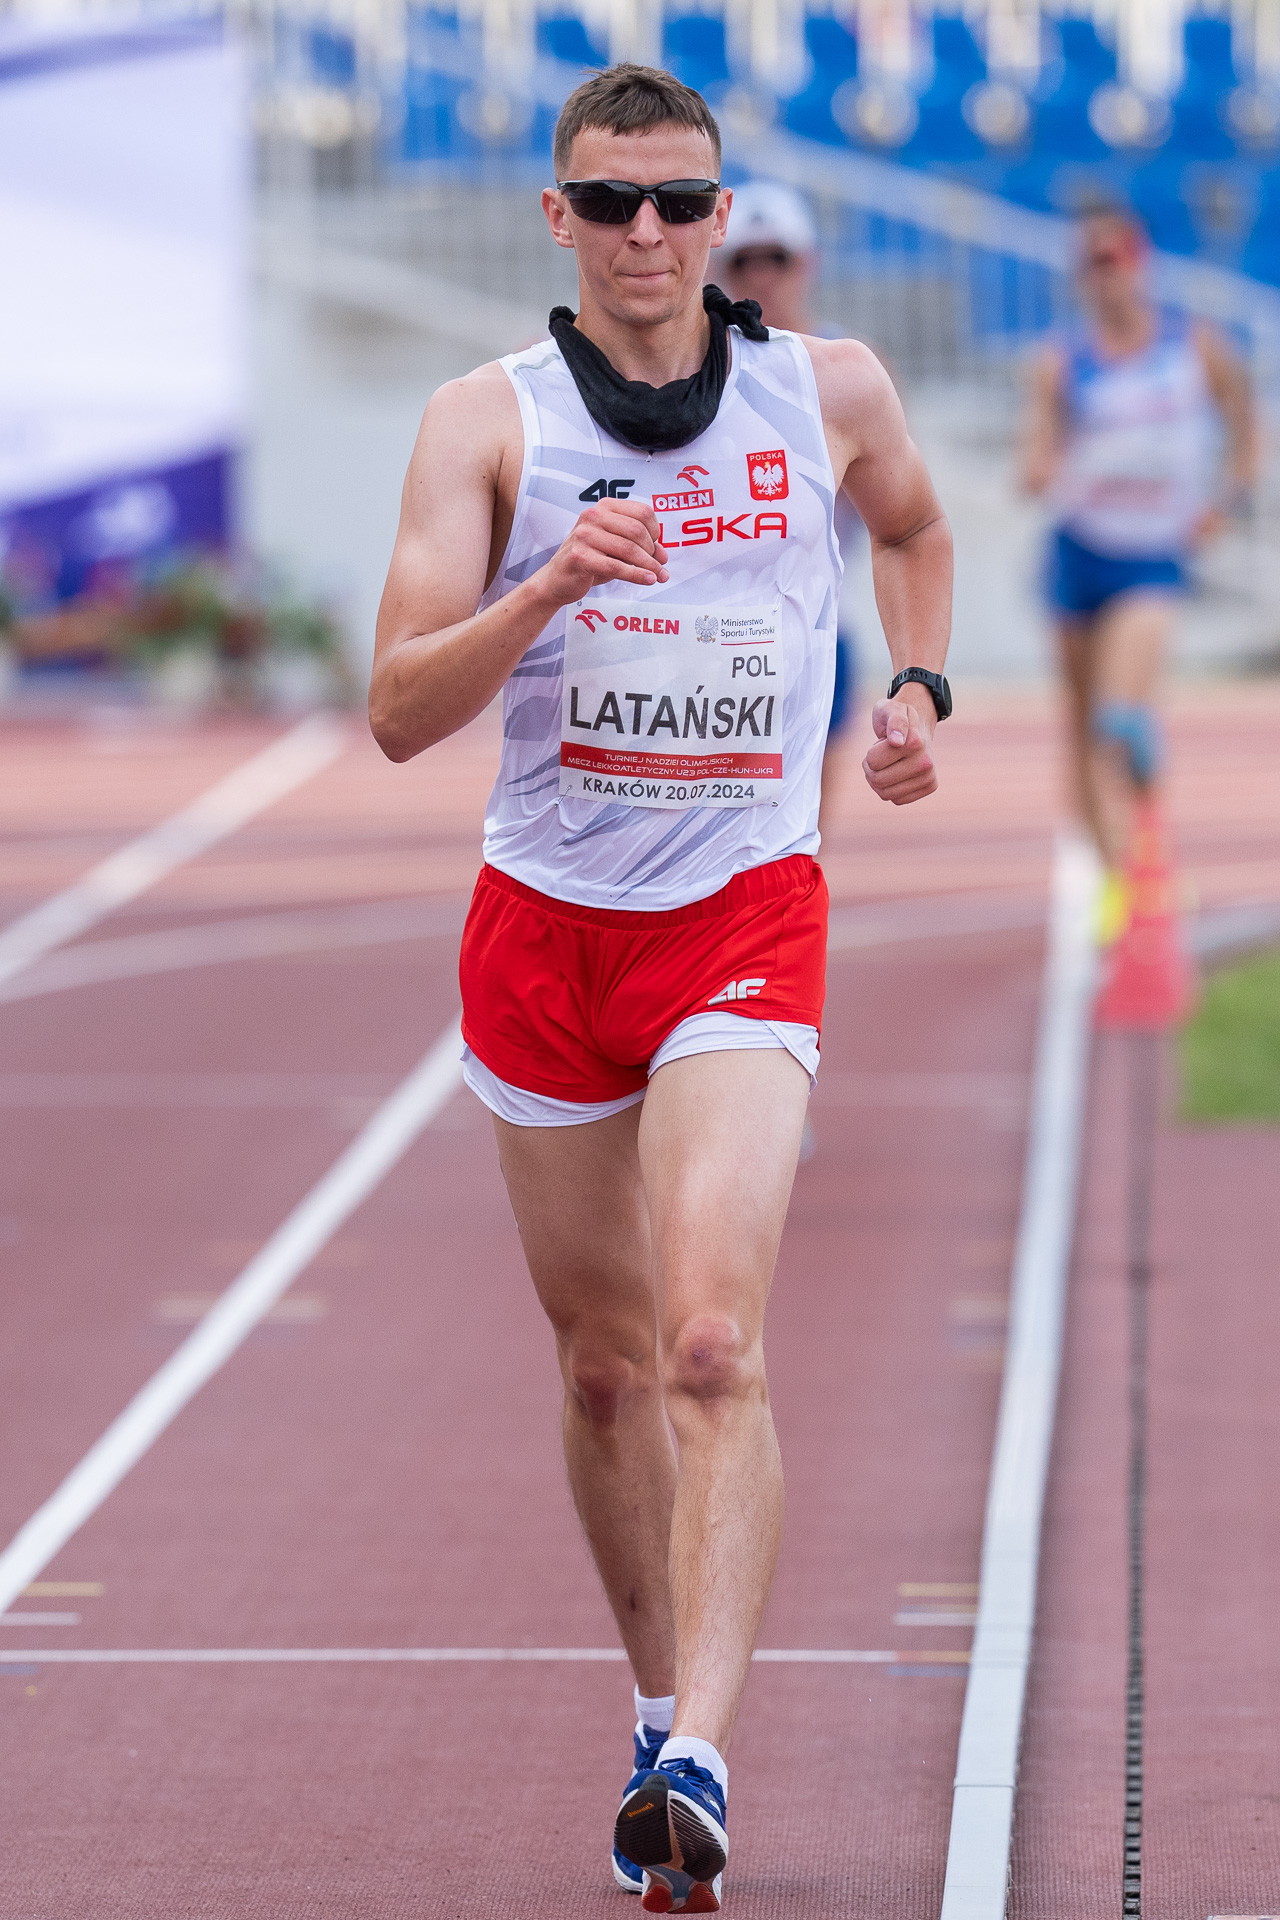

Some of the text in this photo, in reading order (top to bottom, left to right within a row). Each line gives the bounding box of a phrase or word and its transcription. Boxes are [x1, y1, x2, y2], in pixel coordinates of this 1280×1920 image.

[749, 452, 783, 462] POLSKA
[655, 492, 711, 510] ORLEN
[658, 512, 787, 548] LSKA
[613, 615, 680, 635] ORLEN
[720, 618, 764, 627] Ministerstwo
[720, 628, 745, 638] Sportu
[749, 626, 775, 636] Turystyki
[732, 655, 776, 678] POL
[569, 685, 775, 739] LATAŃSKI
[567, 756, 774, 777] MECZ LEKKOATLETYCZNY U23 POL-CZE-HUN-UKR
[604, 753, 644, 764] TURNIEJ
[645, 757, 679, 766] NADZIEI
[583, 776, 755, 800] KRAKÓW 20.07.2024
